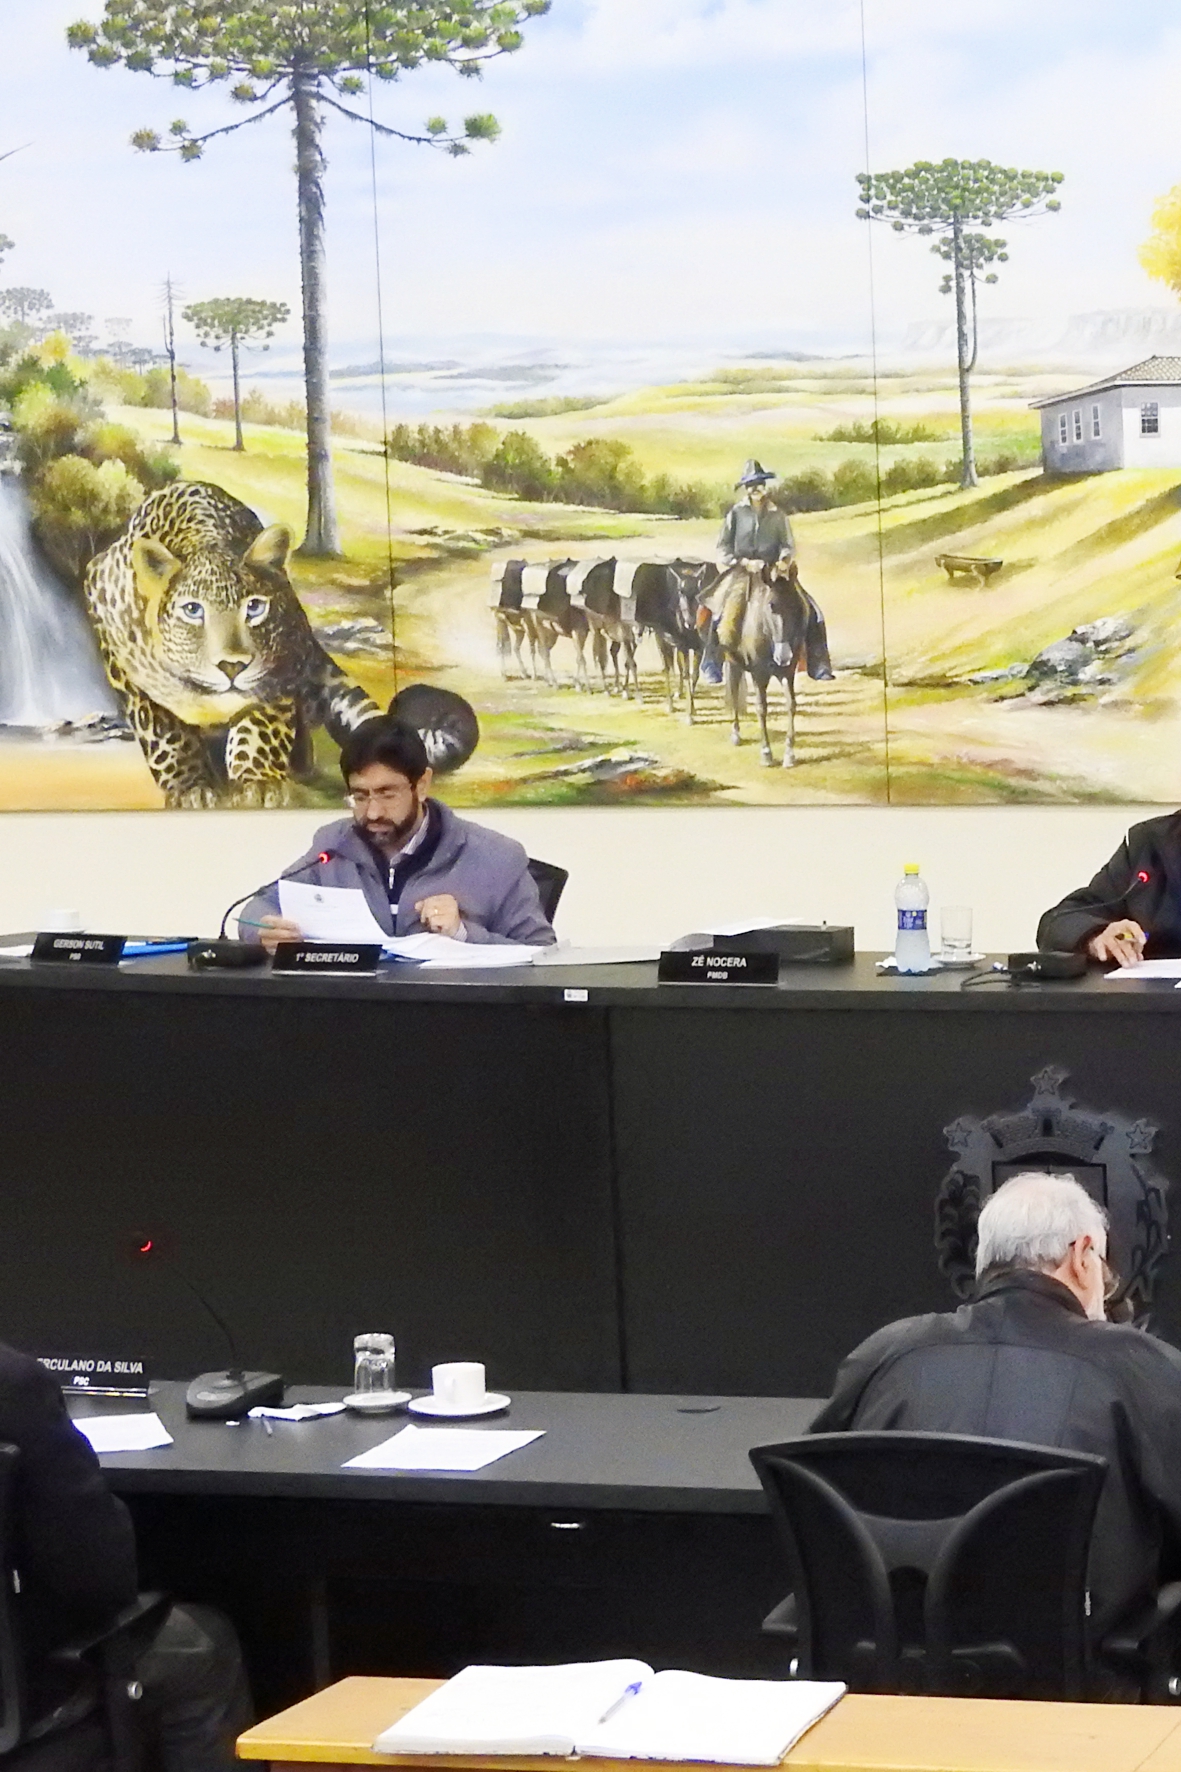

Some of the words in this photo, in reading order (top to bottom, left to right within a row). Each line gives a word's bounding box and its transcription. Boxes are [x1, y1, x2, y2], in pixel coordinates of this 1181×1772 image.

[53, 939, 84, 950] GERSON
[85, 940, 105, 951] SUTIL
[305, 952, 360, 963] SECRETÁRIO
[691, 955, 705, 967] ZÉ
[706, 957, 747, 967] NOCERA
[37, 1357, 95, 1371] RCULANO
[96, 1360, 112, 1372] DA
[114, 1361, 143, 1373] SILVA
